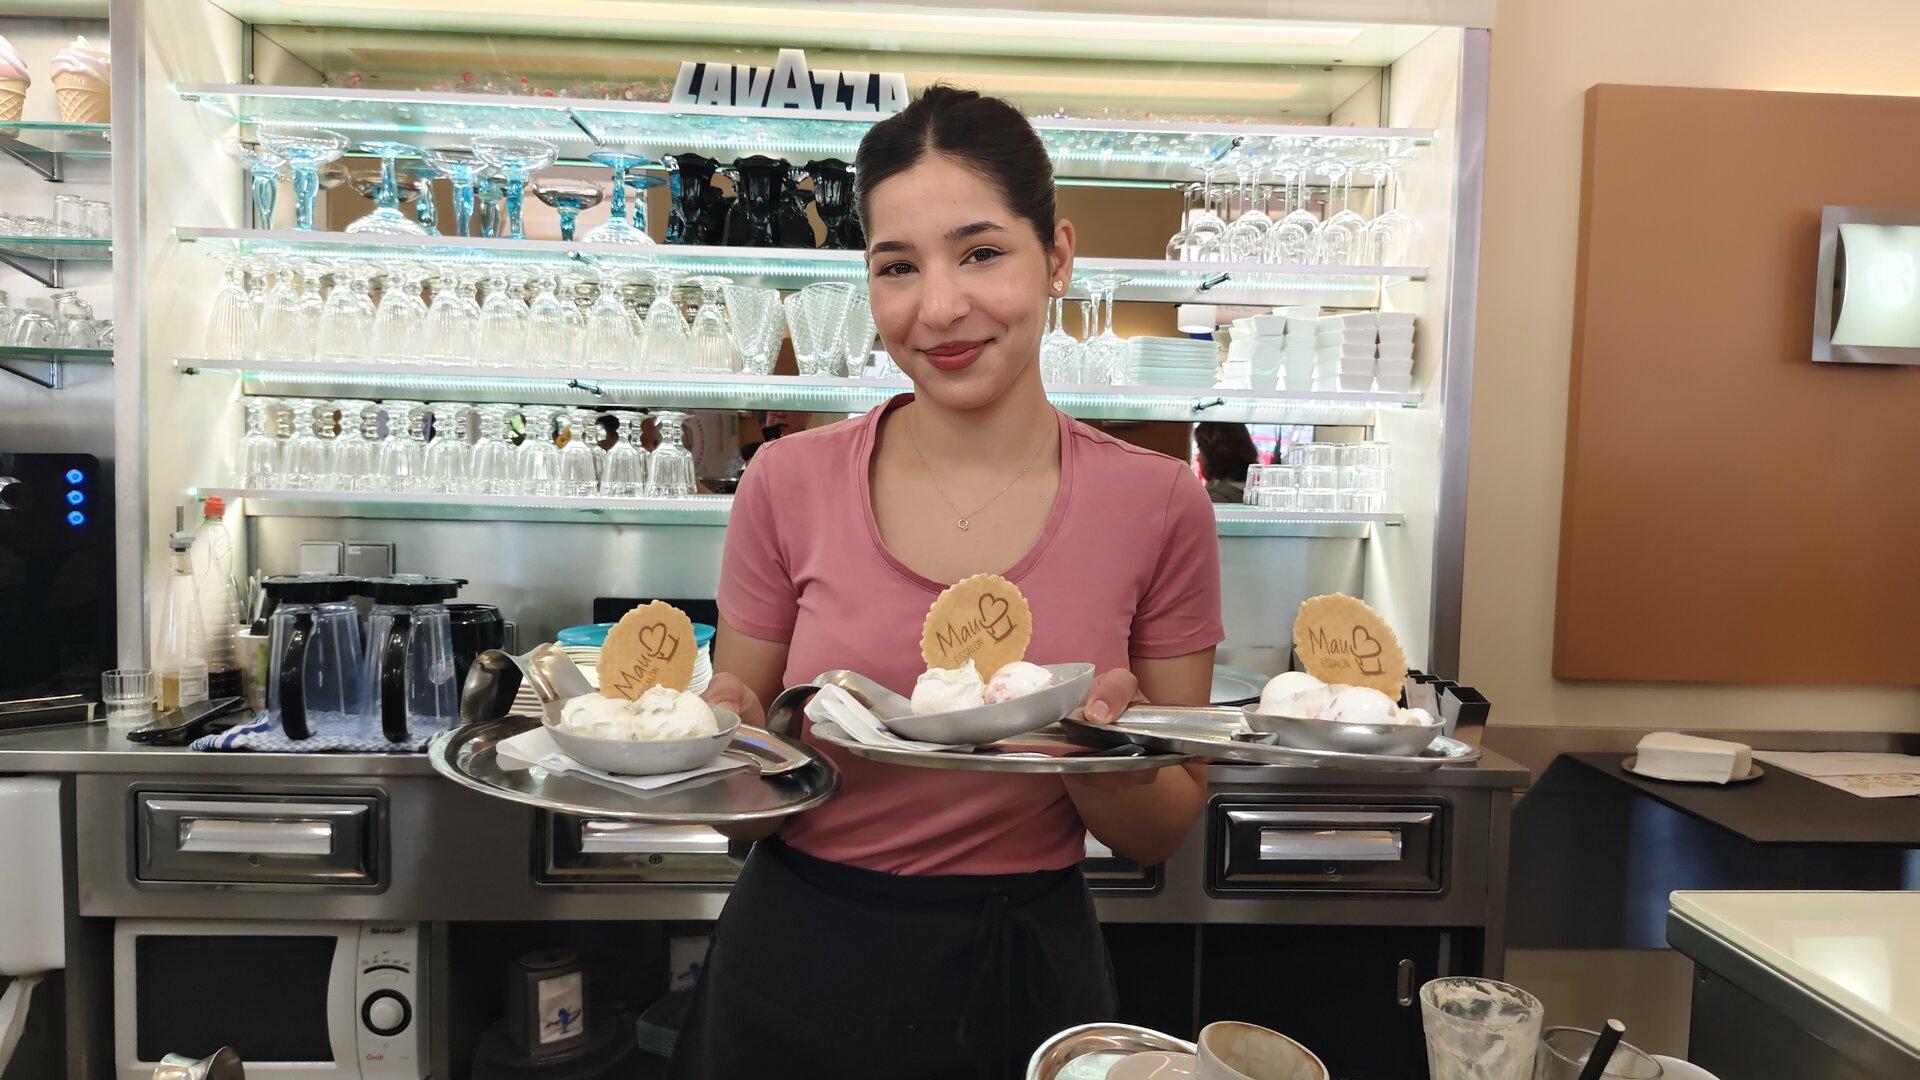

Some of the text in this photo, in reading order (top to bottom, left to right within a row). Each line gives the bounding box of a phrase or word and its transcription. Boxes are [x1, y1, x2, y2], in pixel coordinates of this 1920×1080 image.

[670, 48, 910, 113] LAVAZZA
[936, 617, 981, 658] Mau
[1308, 625, 1349, 655] Mau
[613, 653, 652, 701] Mau
[370, 927, 406, 935] SHARP
